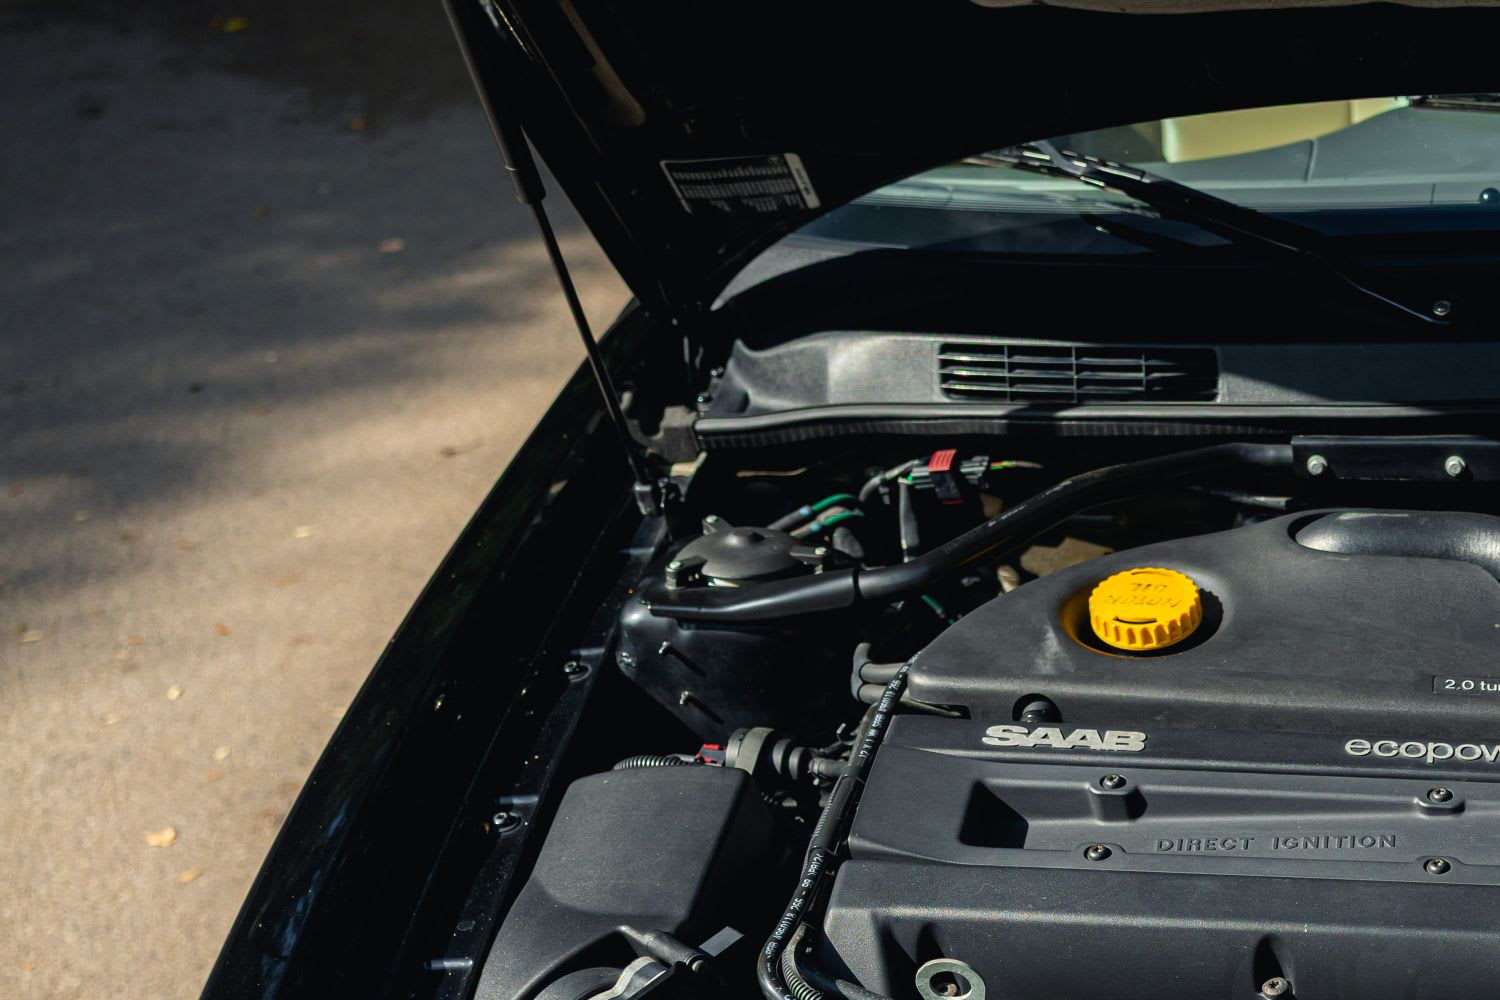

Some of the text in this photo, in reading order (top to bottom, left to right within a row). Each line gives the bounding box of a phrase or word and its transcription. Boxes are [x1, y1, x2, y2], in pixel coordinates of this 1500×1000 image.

[1444, 678, 1474, 692] 2.0
[981, 724, 1149, 752] SAAB
[1155, 833, 1398, 854] DIRECT IGNITION
